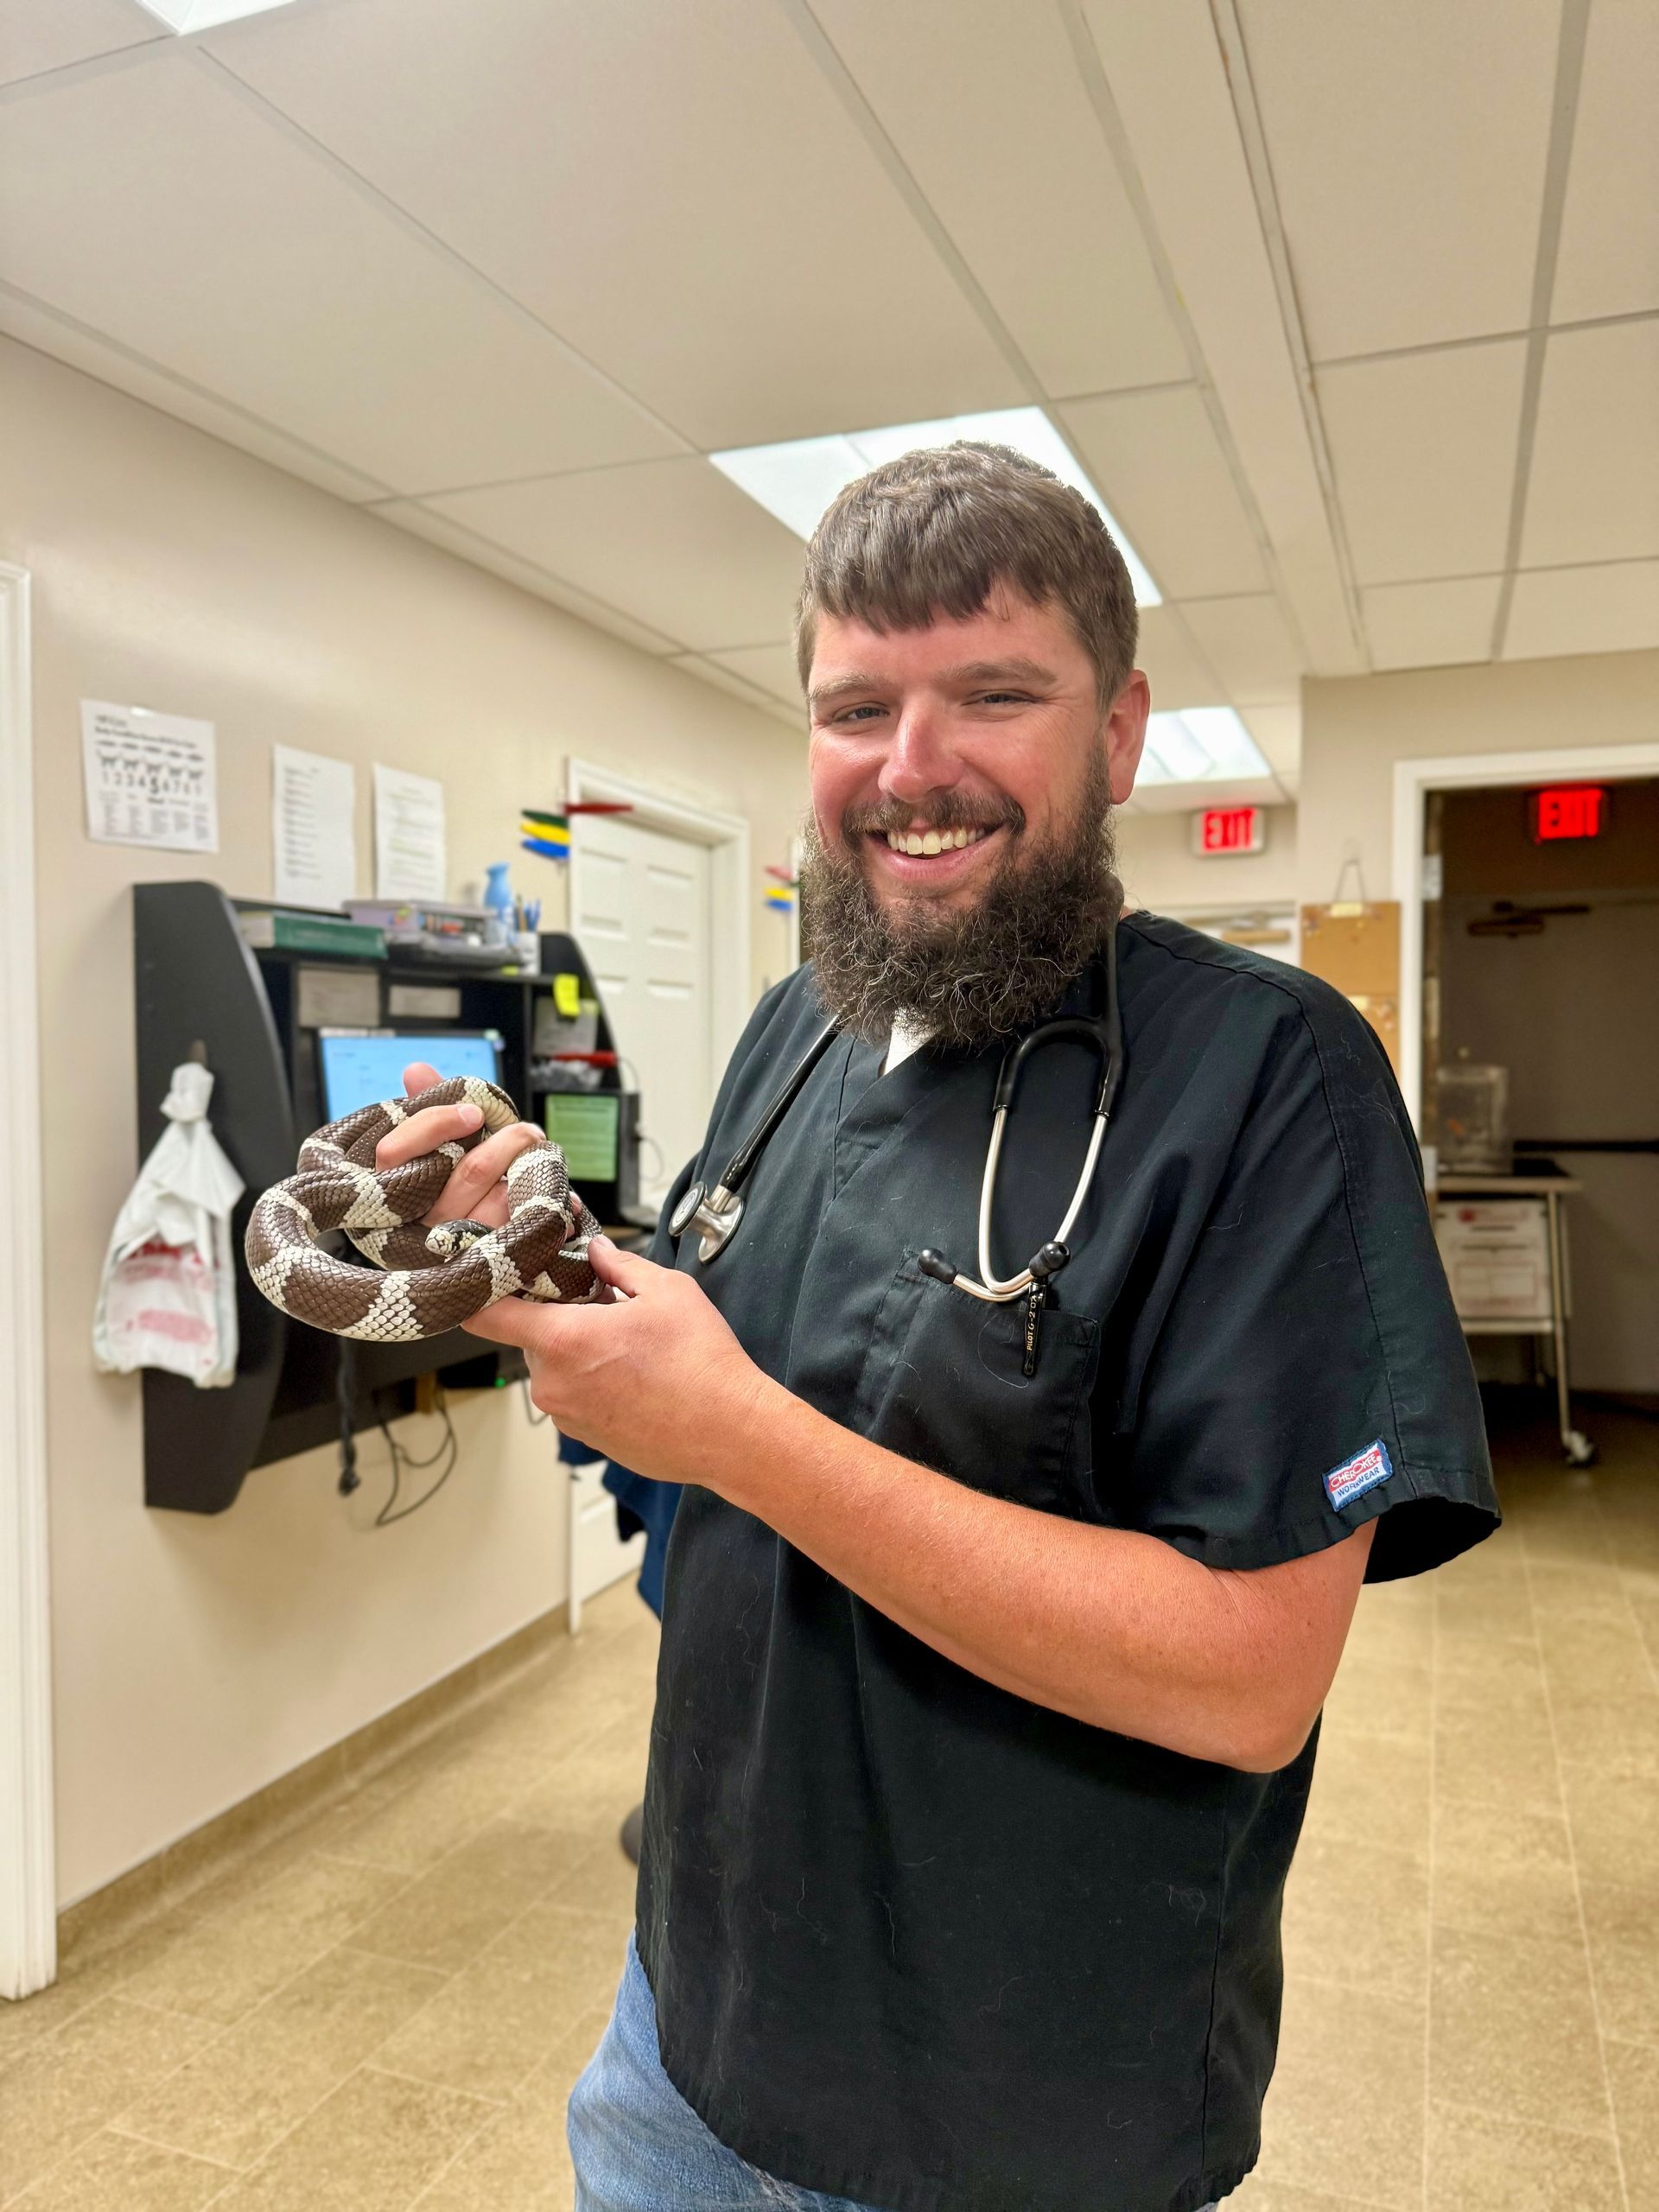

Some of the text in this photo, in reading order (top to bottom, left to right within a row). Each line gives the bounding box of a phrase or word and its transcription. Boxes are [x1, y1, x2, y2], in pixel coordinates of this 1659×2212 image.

[150, 777, 160, 794] 5
[1204, 809, 1255, 851] EXIT
[1538, 789, 1602, 839] EXIT
[1331, 1453, 1376, 1488] CHEROKEE
[1337, 1466, 1380, 1497] WORKWEAR
